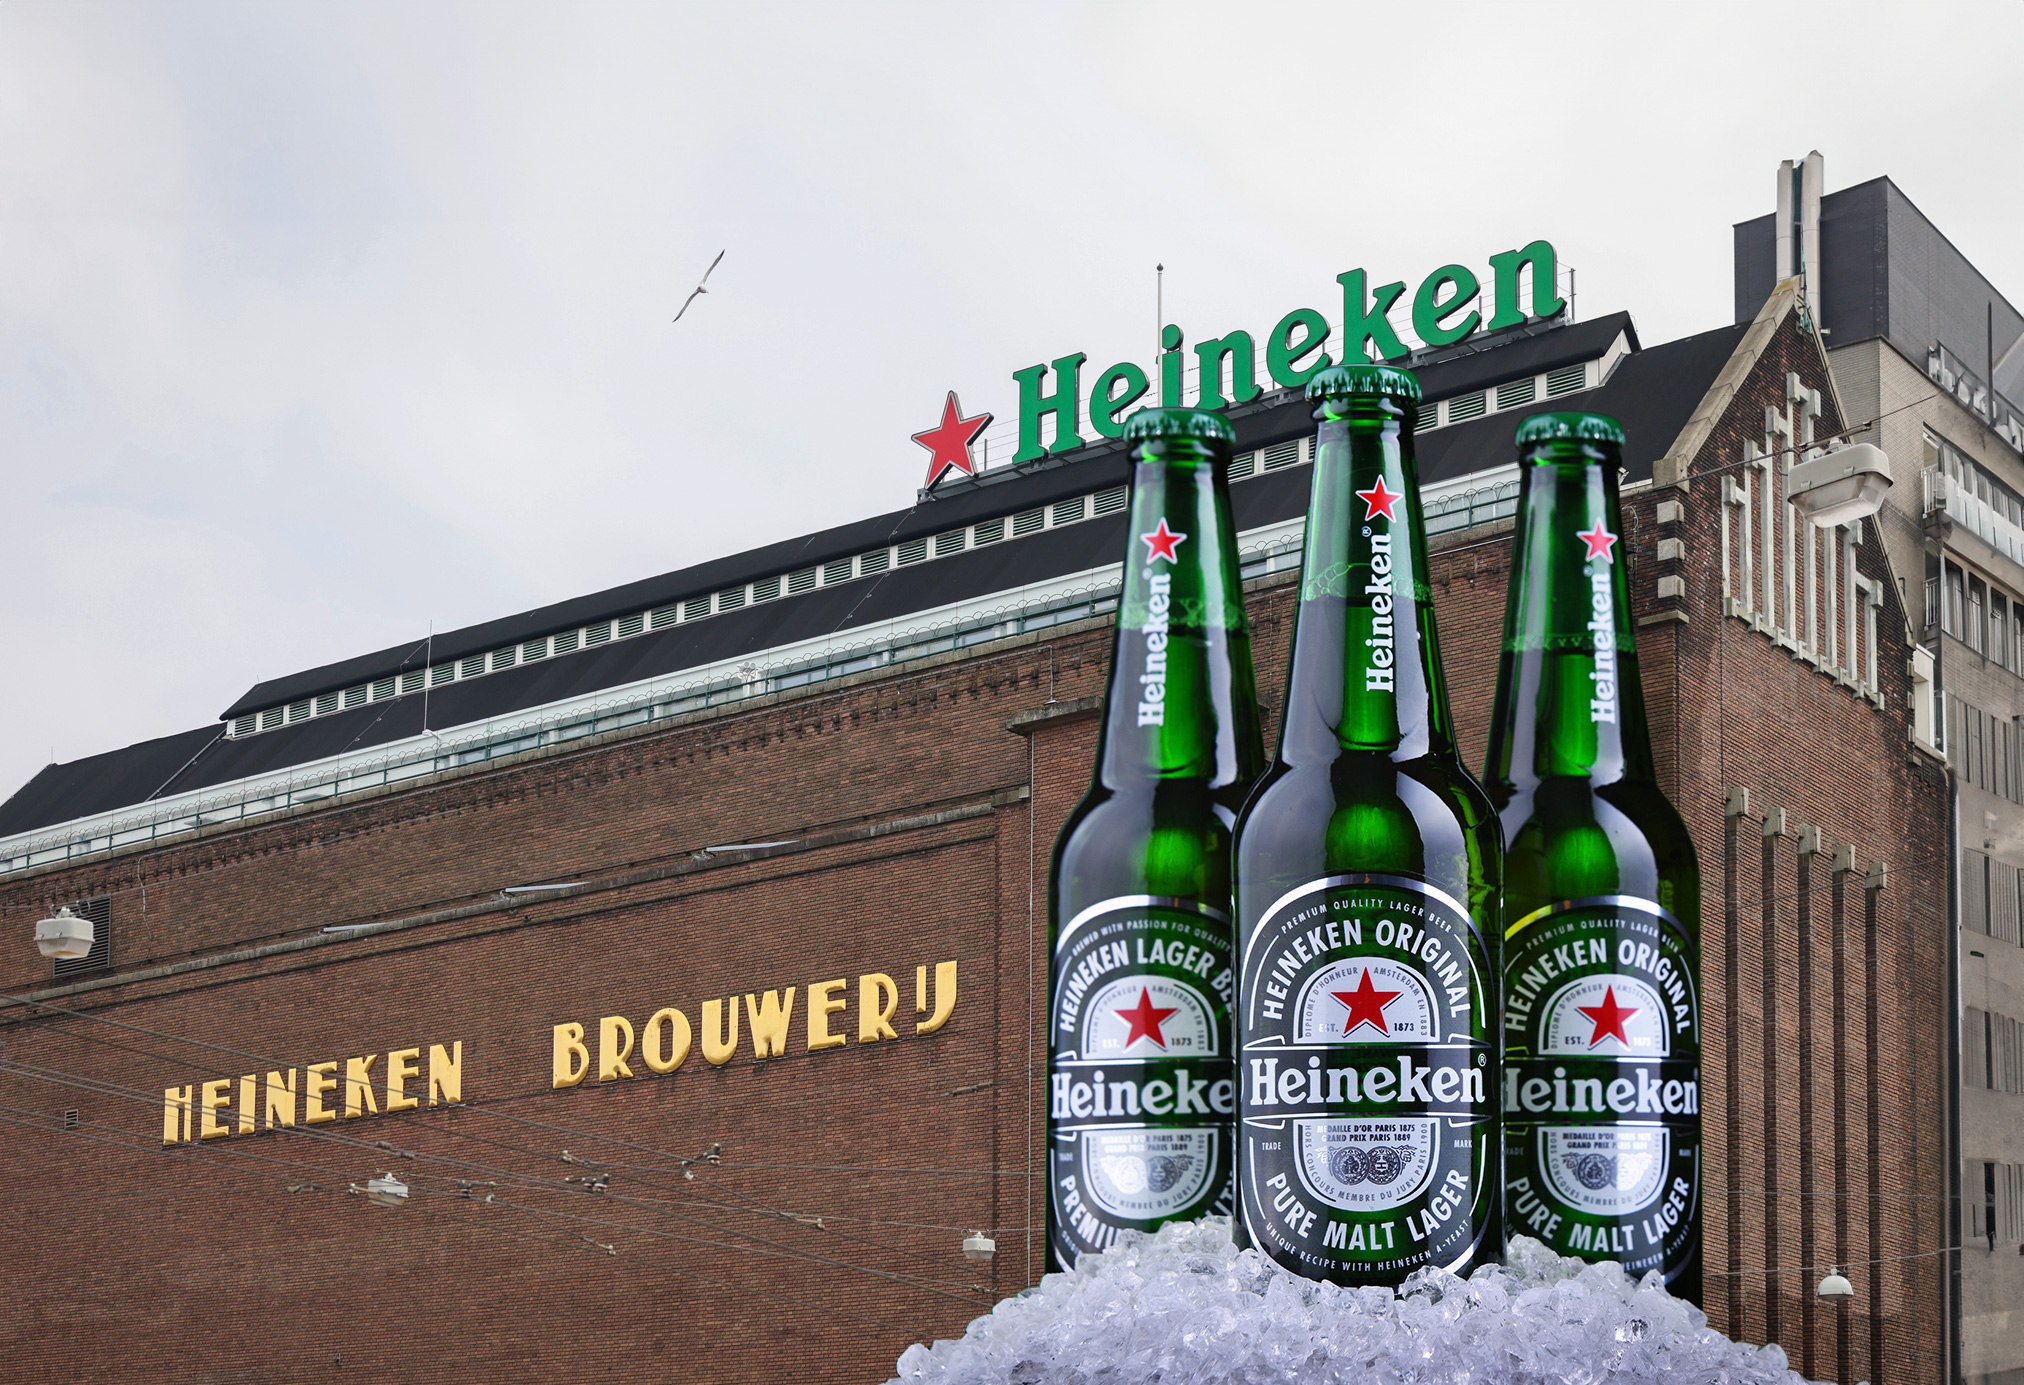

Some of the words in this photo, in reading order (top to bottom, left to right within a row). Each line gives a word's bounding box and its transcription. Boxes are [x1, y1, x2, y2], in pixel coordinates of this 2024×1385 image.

[1012, 240, 1567, 464] Heineken
[1101, 922, 1124, 936] WITH
[1126, 919, 1168, 930] PASSION
[1171, 922, 1189, 933] FOR
[1281, 904, 1328, 934] PREMIUM
[1333, 899, 1383, 909] QUALITY
[1389, 901, 1424, 917] LAGER
[1428, 913, 1452, 933] BEER
[1526, 923, 1575, 950] PREMIUM
[1580, 919, 1626, 930] QUALITY
[1630, 922, 1660, 938] LAGER
[1263, 919, 1362, 1020] HEINEKEN
[1375, 919, 1471, 1018] ORIGINAL
[1312, 967, 1358, 996] D'HONNEUR
[1374, 966, 1420, 997] AMSTERDAM
[1059, 939, 1129, 1033] HEINEKEN
[1136, 938, 1216, 979] LAGER
[1505, 938, 1607, 1032] HEINEKEN
[1618, 939, 1691, 1035] ORIGINAL
[1305, 998, 1316, 1037] DIPLOME
[1417, 999, 1425, 1010] EN
[1319, 1023, 1339, 1033] EST.
[1394, 1022, 1415, 1032] 1873
[1420, 1014, 1428, 1036] 1883
[163, 1040, 463, 1146] HEINEKEN
[552, 960, 959, 1089] BROUWERIJ
[1171, 1037, 1192, 1046] 1873
[1565, 1036, 1585, 1045] EST.
[1152, 1134, 1173, 1142] PARIS
[1317, 1124, 1351, 1133] MEDAILLE
[1353, 1124, 1373, 1133] D'OR
[1375, 1124, 1397, 1132] PARIS
[1399, 1124, 1415, 1132] 1875
[1321, 1133, 1347, 1142] GRAND
[1349, 1133, 1367, 1142] PRIX
[1369, 1133, 1391, 1141] PARIS
[1393, 1133, 1411, 1141] 1889
[1420, 1123, 1428, 1144] 1900
[1262, 1141, 1282, 1150] TRADE
[1454, 1139, 1472, 1149] MARK
[1305, 1153, 1336, 1195] CONCOURS
[1414, 1149, 1427, 1176] PARIS
[1337, 1191, 1375, 1202] MEMBRE
[1380, 1190, 1393, 1200] DU
[1396, 1177, 1416, 1195] JURY
[1266, 1172, 1318, 1239] PURE
[1322, 1220, 1395, 1250] MALT
[1405, 1169, 1469, 1242] LAGER
[1507, 1176, 1563, 1240] PURE
[1568, 1223, 1635, 1252] MALT
[1642, 1176, 1690, 1245] LAGER
[1266, 1222, 1296, 1255] UNIQUE
[1299, 1251, 1336, 1270] RECIPE
[1342, 1261, 1371, 1272] WITH
[1377, 1249, 1432, 1271] HEINEKEN
[1436, 1219, 1469, 1254] A-YEAST
